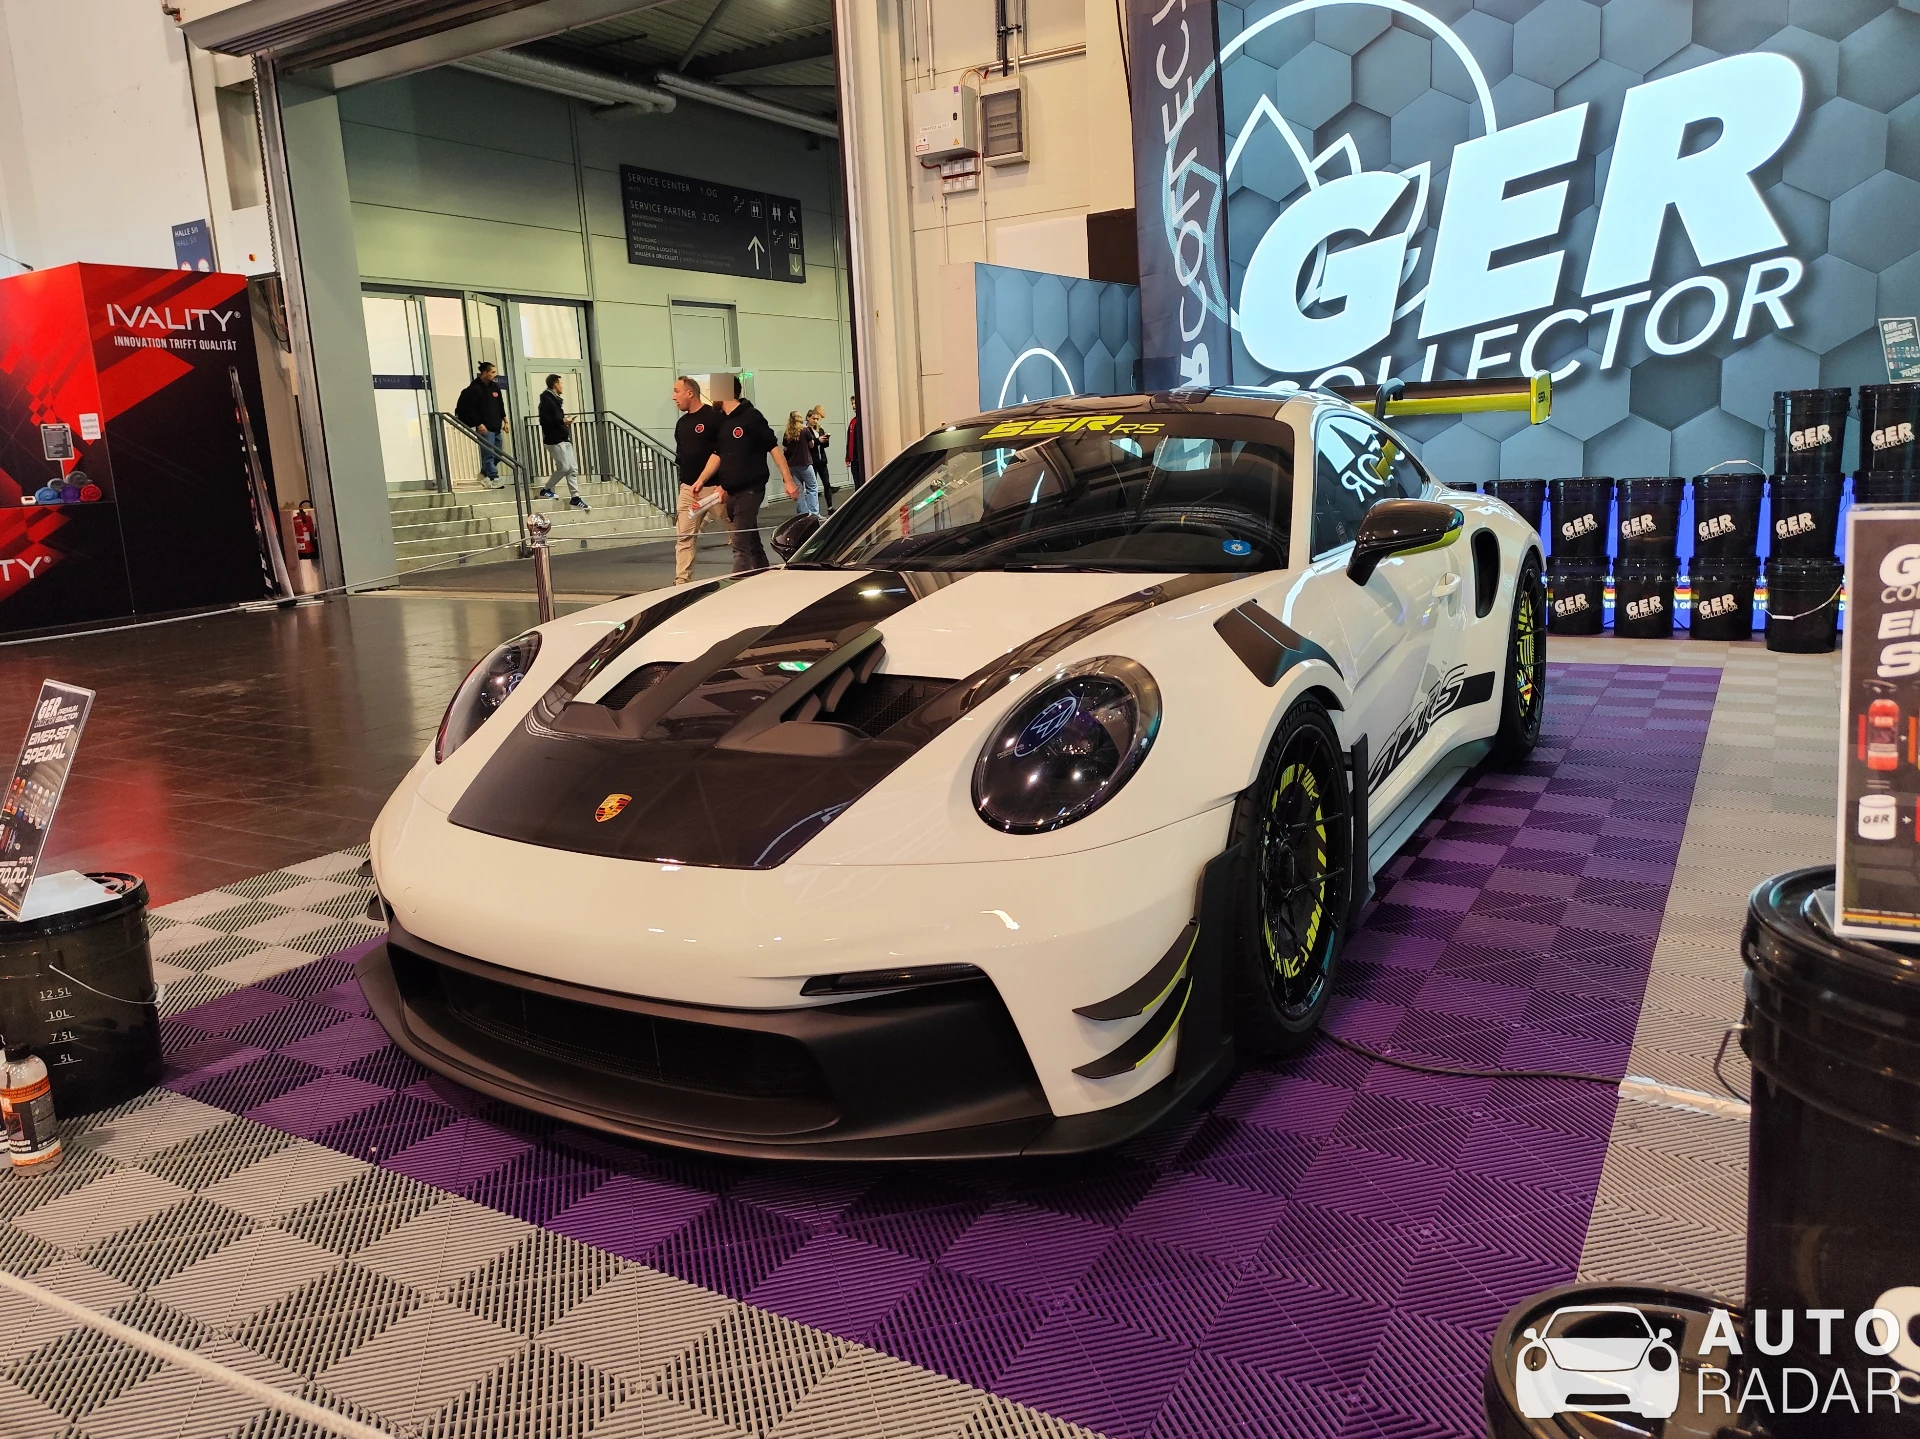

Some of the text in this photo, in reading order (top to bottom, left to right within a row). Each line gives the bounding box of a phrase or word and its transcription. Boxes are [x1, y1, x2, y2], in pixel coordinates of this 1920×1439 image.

[628, 173, 659, 187] SERVICE
[662, 179, 690, 193] CENTER
[630, 200, 662, 214] SERVICE
[664, 205, 697, 219] PARTNER
[1239, 51, 1804, 372] GER
[174, 227, 190, 237] HALLE
[114, 336, 237, 351] INNOVATION TRIFFT QUALITÄT
[1109, 423, 1165, 434] RS
[1790, 424, 1831, 446] GER
[1871, 422, 1913, 445] GER
[1791, 436, 1833, 453] COLLECTOR
[1873, 434, 1915, 452] COLLECTOR
[1562, 513, 1595, 537] GER
[1621, 513, 1654, 534] GER
[1698, 513, 1733, 537] GER
[1776, 512, 1813, 534] GER
[1778, 523, 1816, 540] COLLECTOR
[1565, 524, 1598, 541] COLLECTOR
[1623, 525, 1657, 540] COLLECTOR
[1700, 524, 1736, 541] COLLECTOR
[1554, 593, 1588, 614] GER
[1556, 602, 1590, 618] COLLECTOR
[1626, 595, 1662, 616] GER
[1699, 593, 1736, 615] GER
[1701, 603, 1739, 620] COLLECTOR
[1628, 606, 1664, 621] COLLECTOR
[38, 697, 62, 721] GER
[28, 725, 74, 747] EIMER-SET
[22, 742, 66, 766] SPECIAL
[1862, 814, 1890, 824] GER
[39, 987, 72, 999] 12.5L
[48, 1009, 70, 1020] 10L
[51, 1031, 76, 1042] 7.5L
[60, 1053, 74, 1063] 5L
